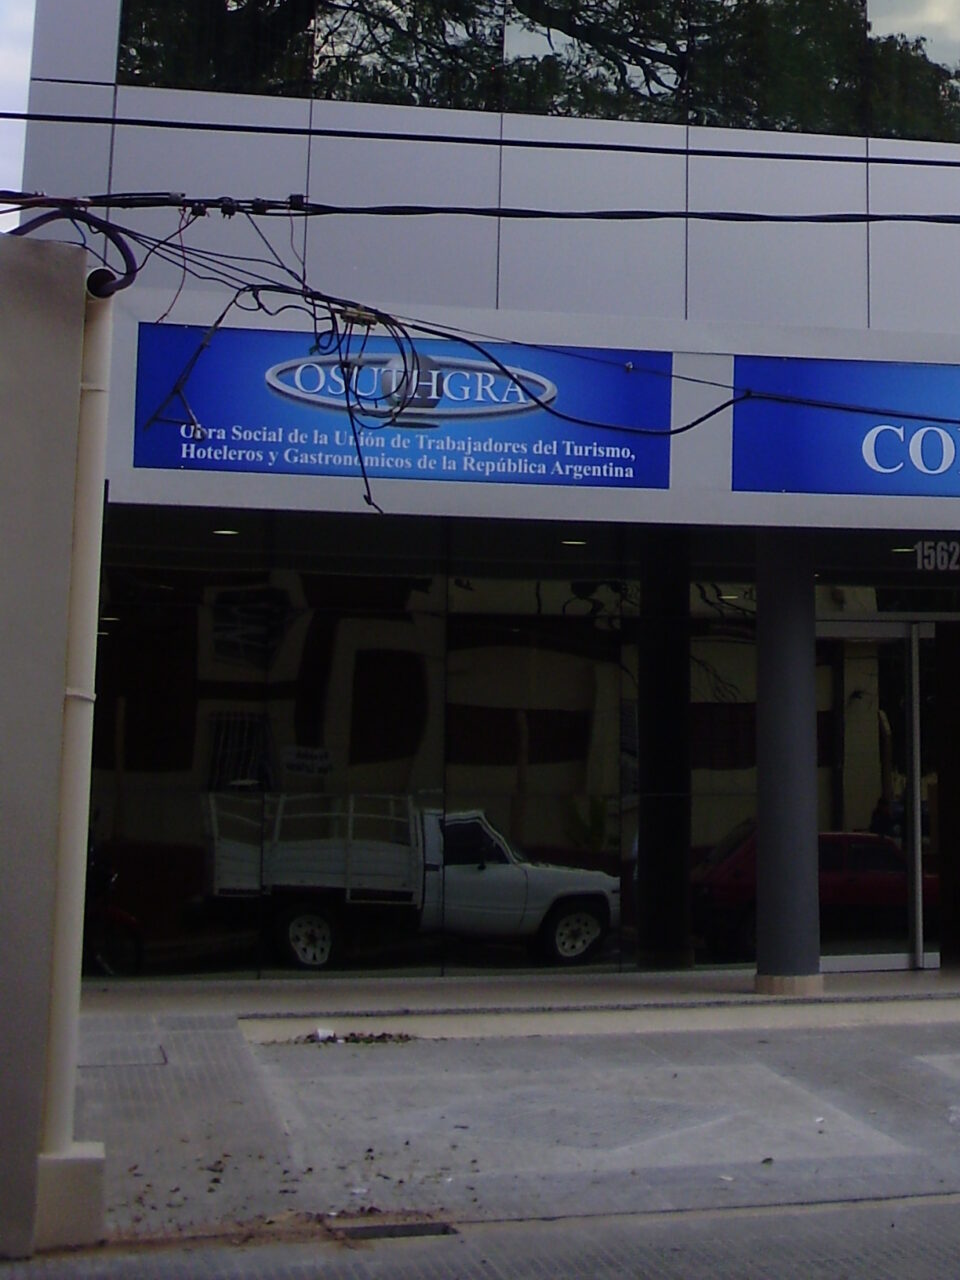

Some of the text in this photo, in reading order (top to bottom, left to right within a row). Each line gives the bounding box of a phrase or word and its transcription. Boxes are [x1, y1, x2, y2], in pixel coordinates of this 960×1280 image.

[294, 362, 529, 404] OSUTHGRA
[231, 425, 283, 442] Social
[288, 428, 309, 445] de
[313, 430, 328, 444] la
[391, 433, 410, 448] de
[415, 434, 528, 455] Trabajadores
[532, 439, 557, 456] del
[562, 440, 636, 461] Turismo,
[181, 443, 263, 461] Hoteleros
[268, 449, 279, 466] y
[417, 454, 437, 469] de
[442, 456, 456, 470] la
[462, 456, 546, 476] República
[551, 461, 634, 480] Argentina
[914, 541, 960, 570] 1562
